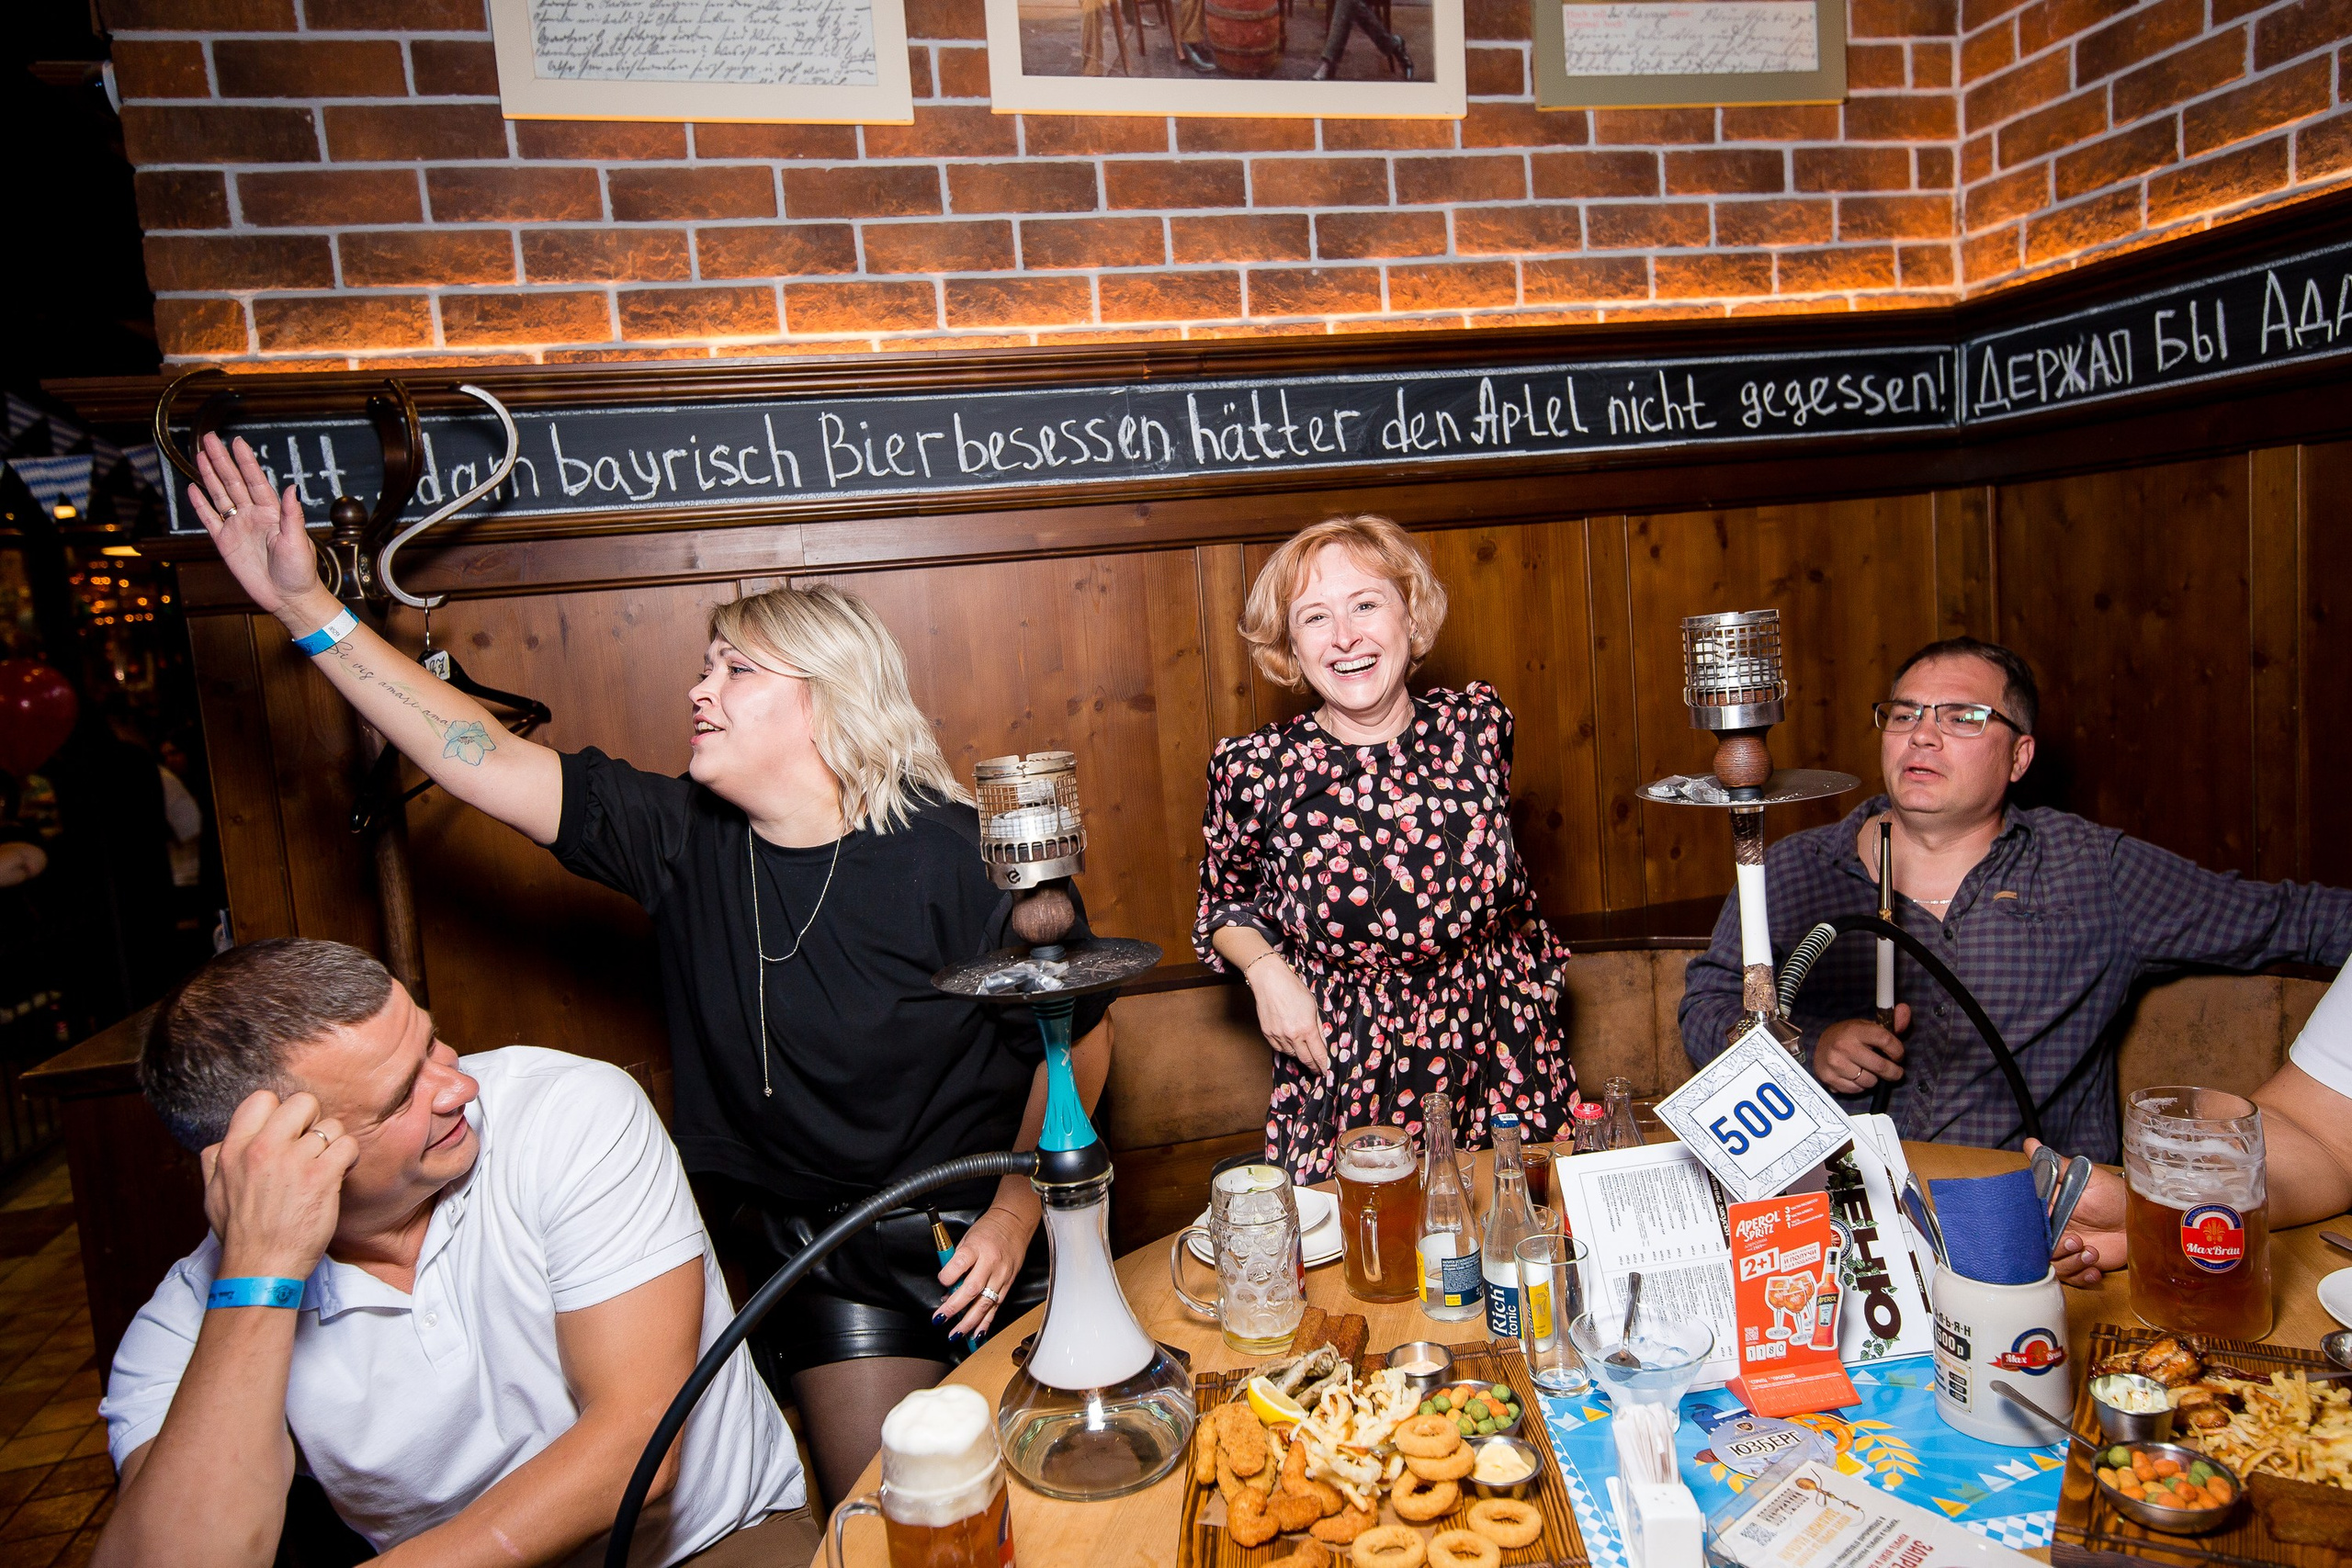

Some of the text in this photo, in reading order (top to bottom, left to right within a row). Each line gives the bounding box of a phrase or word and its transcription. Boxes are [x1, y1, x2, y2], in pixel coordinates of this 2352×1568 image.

[2154, 299, 2229, 373] БЫ
[549, 412, 802, 502] bayrisch
[1382, 386, 1461, 453] den
[1609, 369, 1717, 435] nicht
[1740, 355, 1947, 429] gegessen!
[1709, 1082, 1795, 1156] 500
[1736, 1211, 1781, 1238] APEROL
[1785, 1213, 1792, 1222] 2
[1744, 1251, 1775, 1277] 2+1
[1489, 1286, 1509, 1336] Rich
[1508, 1304, 1519, 1337] tonic
[1748, 1344, 1785, 1359] 1180
